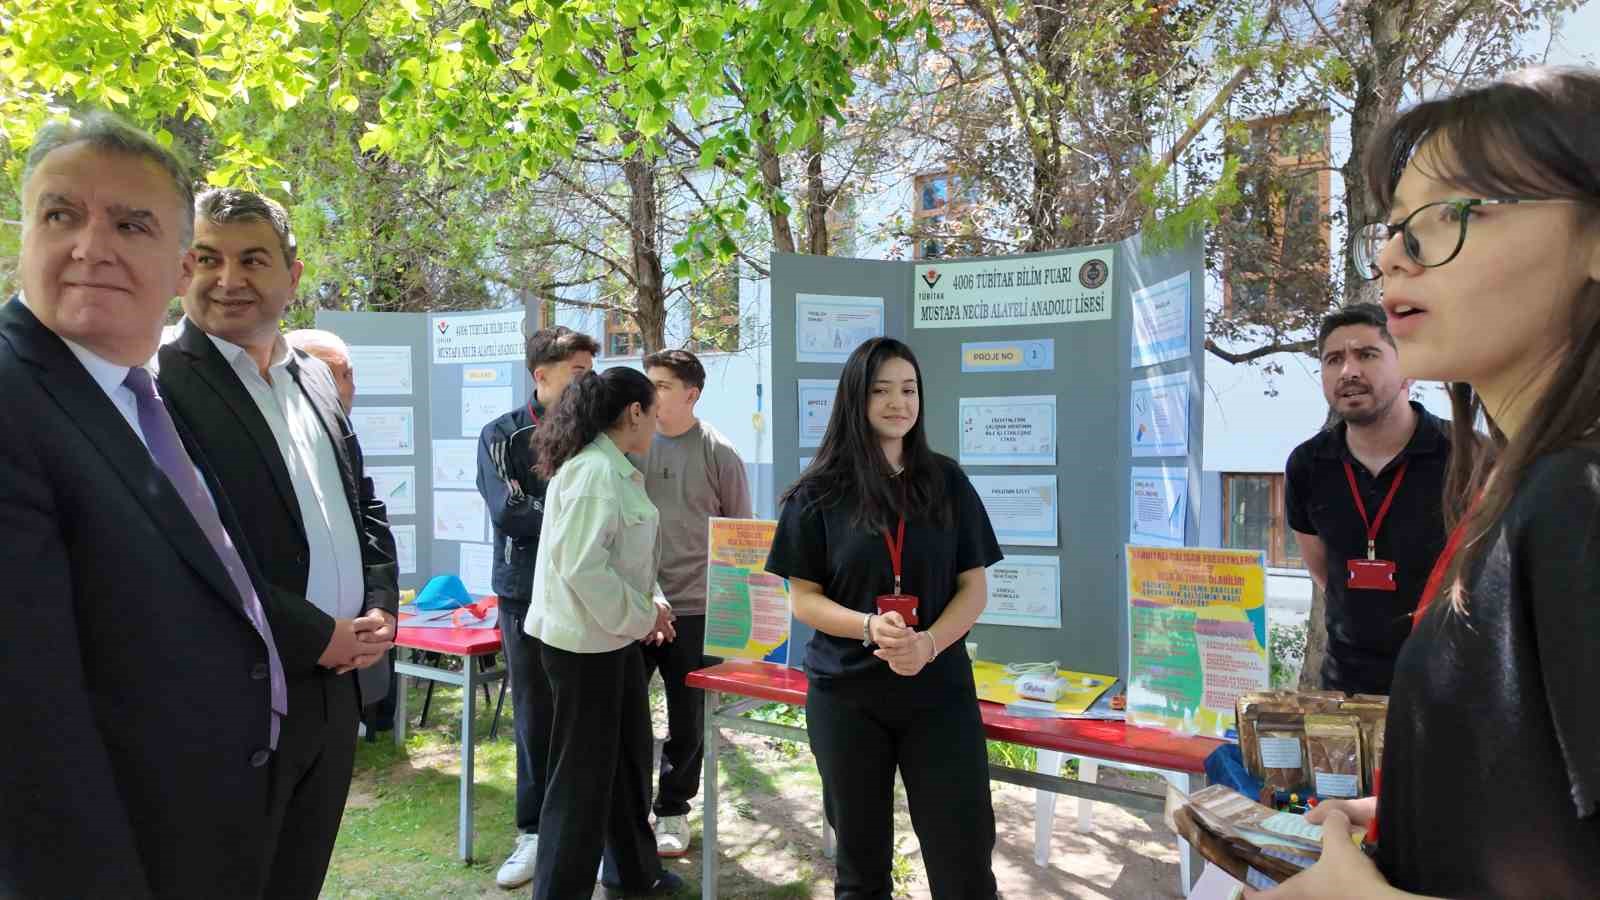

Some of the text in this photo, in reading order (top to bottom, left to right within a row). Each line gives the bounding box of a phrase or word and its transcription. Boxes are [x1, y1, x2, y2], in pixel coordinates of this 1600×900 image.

[953, 266, 1072, 290] 4006 TÜBİTAK BİLİM FUARI
[920, 291, 1105, 321] MUSTAFA NECİB ALAYELİ ANADOLU LİSESİ
[973, 351, 1014, 361] PROJE NO
